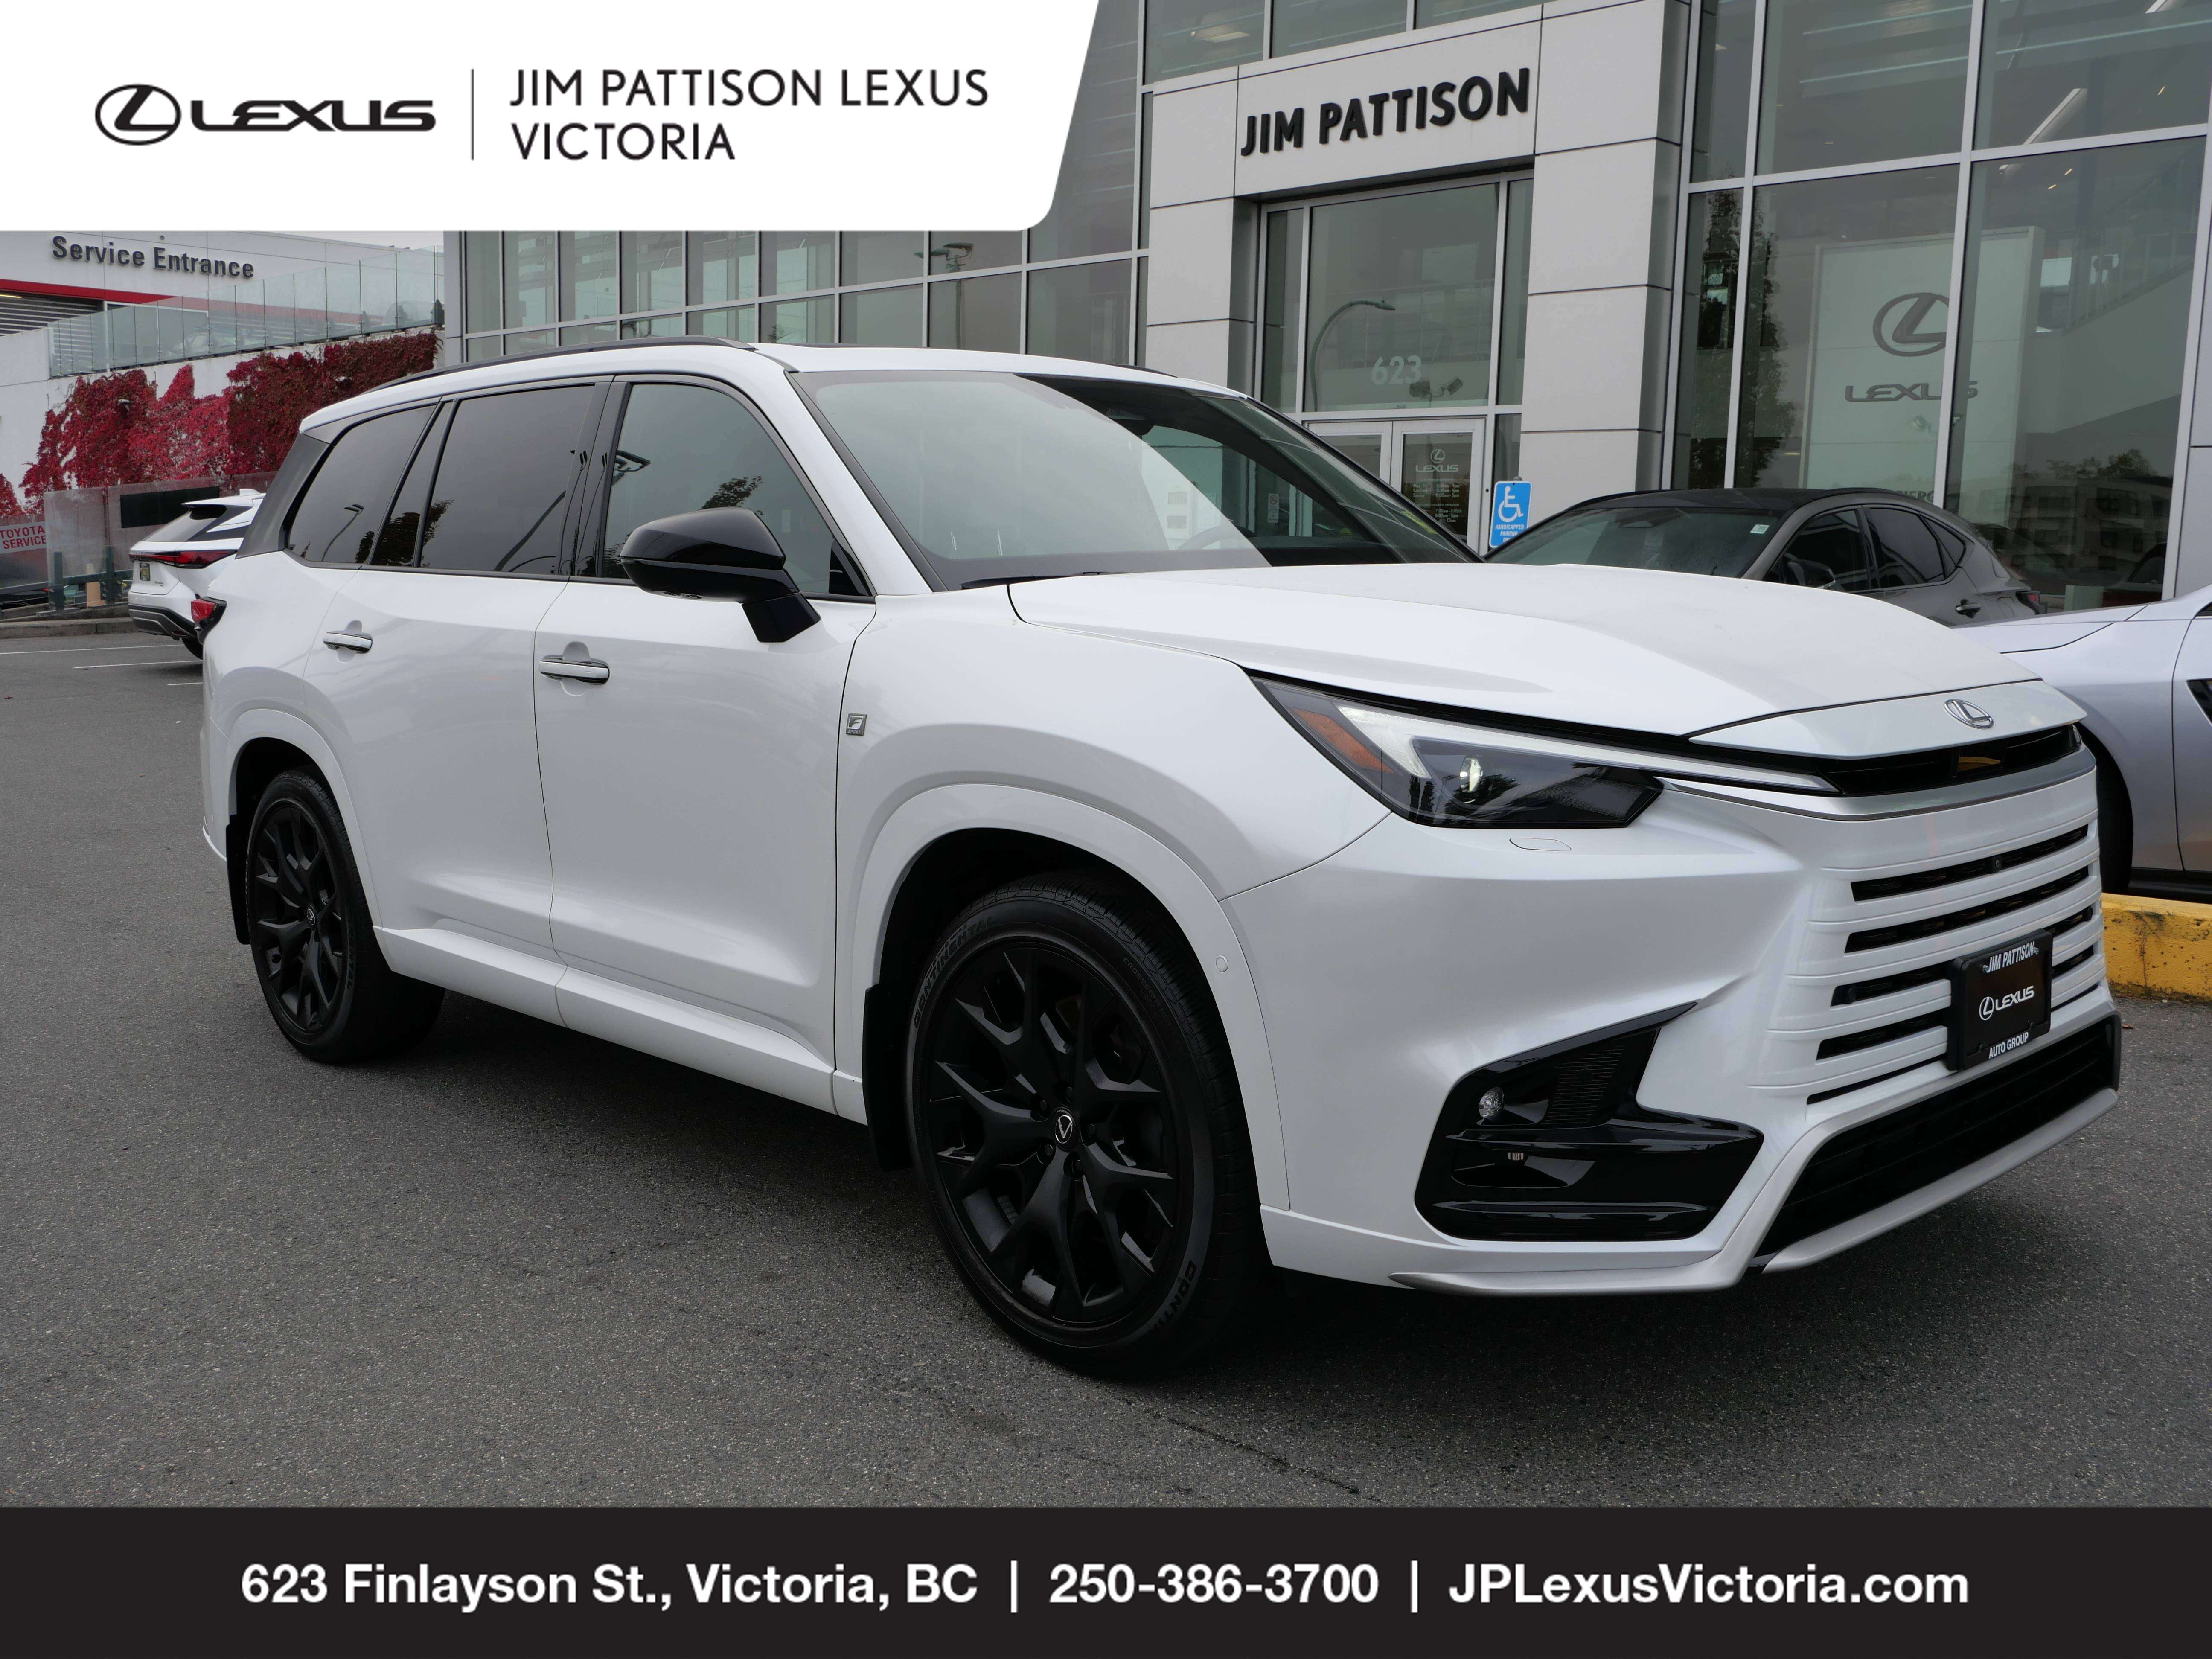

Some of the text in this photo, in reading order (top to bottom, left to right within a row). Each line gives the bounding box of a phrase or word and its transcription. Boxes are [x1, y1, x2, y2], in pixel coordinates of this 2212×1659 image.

[1241, 67, 1530, 156] JIM PATTISON
[52, 236, 254, 278] Service Entrance
[1371, 355, 1421, 385] 623
[1416, 464, 1458, 472] LEXUS
[0, 525, 45, 538] TOYOTA
[3, 536, 46, 549] SERVICE
[1986, 941, 2035, 973] JIM PATTISON
[1995, 985, 2034, 1011] LEXUS
[1989, 1032, 2029, 1059] AUTO GROUP
